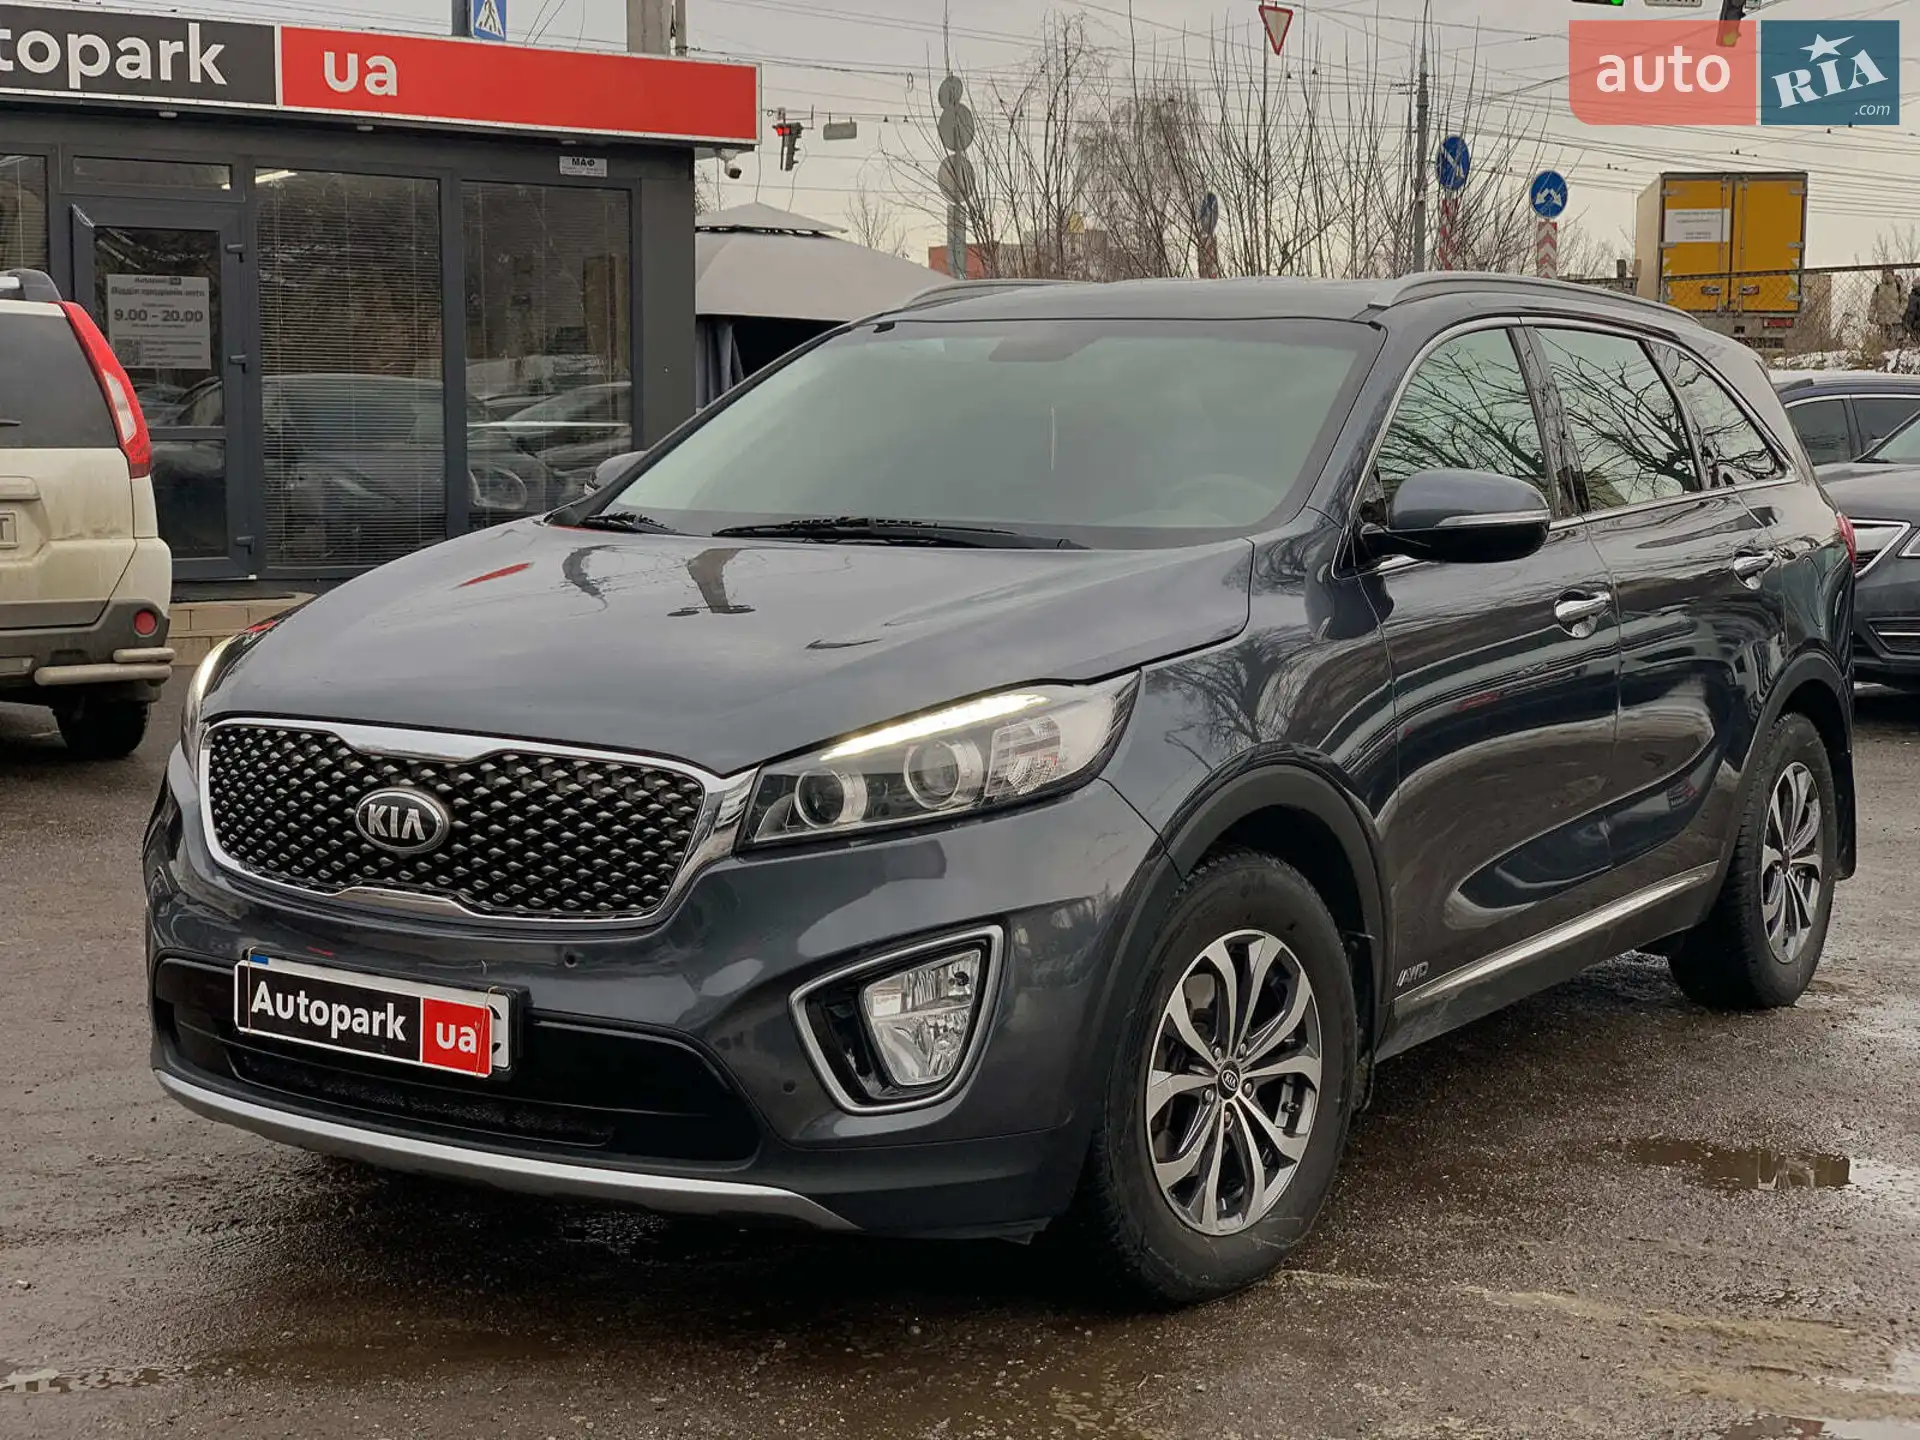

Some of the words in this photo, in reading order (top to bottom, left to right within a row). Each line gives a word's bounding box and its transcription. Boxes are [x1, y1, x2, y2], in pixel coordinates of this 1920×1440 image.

[323, 50, 399, 98] ua
[114, 308, 149, 322] 9.00
[162, 310, 204, 323] 20.00
[367, 803, 426, 841] KIA
[250, 980, 407, 1042] Autopark
[435, 1020, 479, 1055] ua
